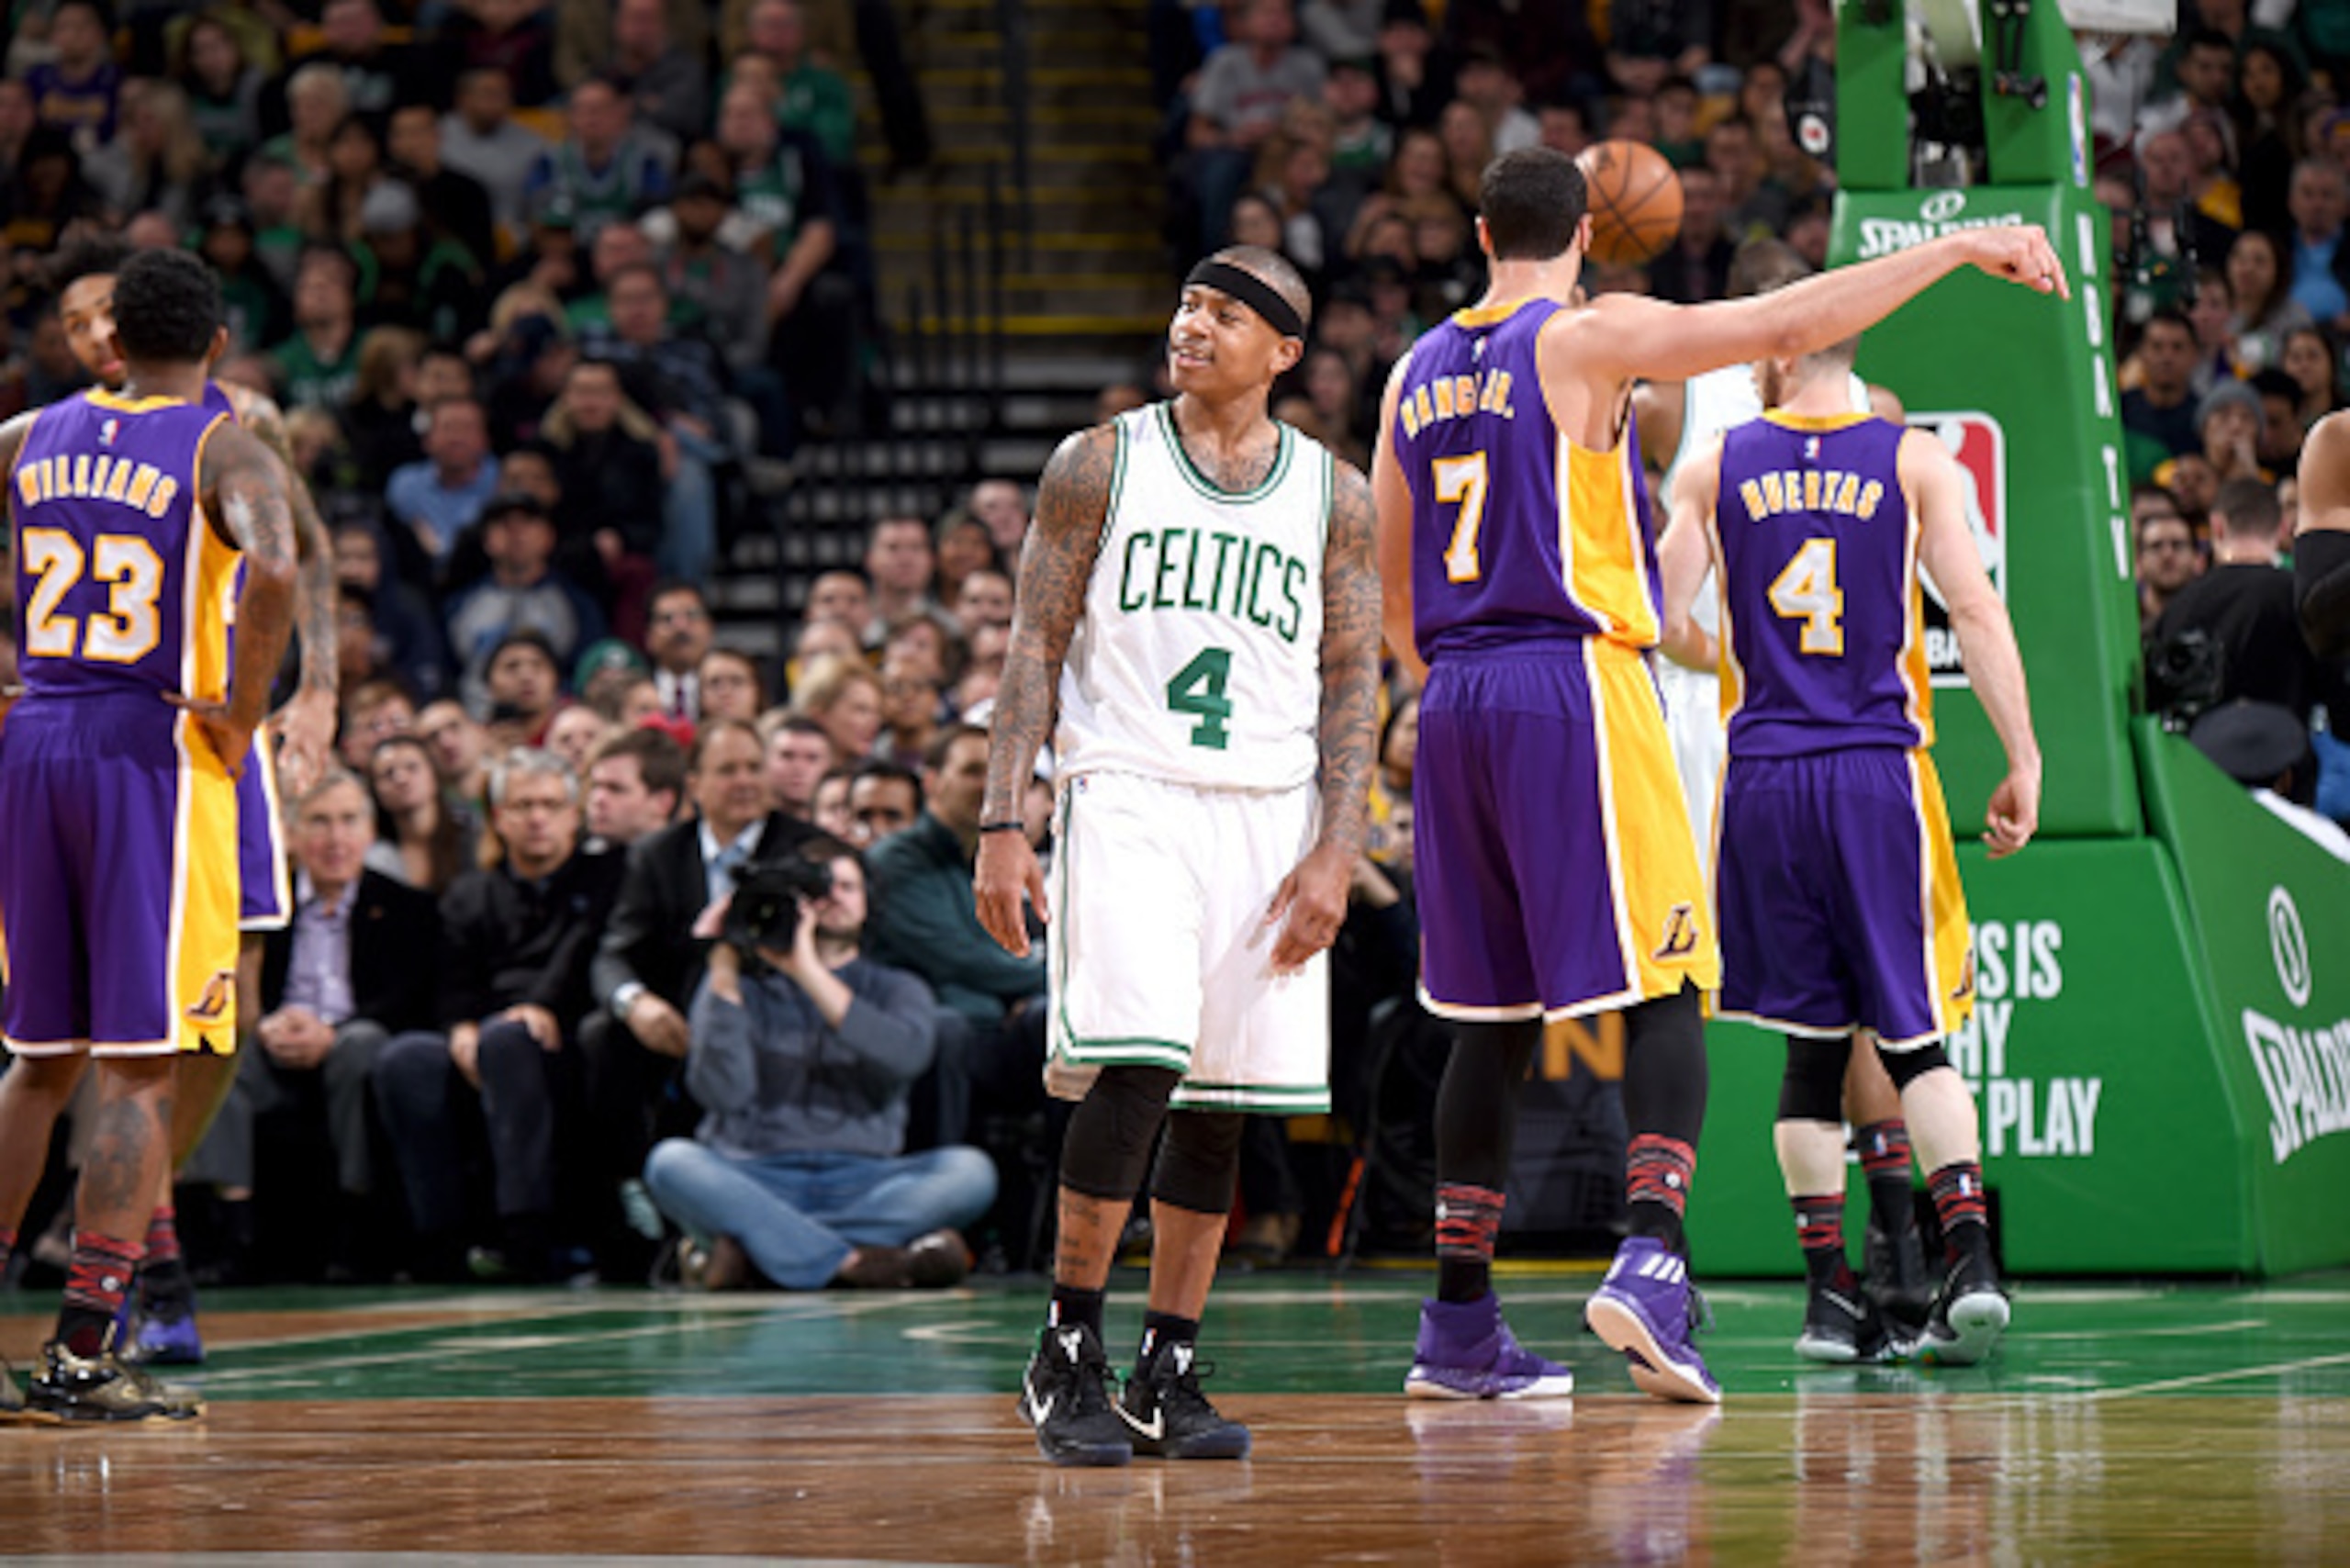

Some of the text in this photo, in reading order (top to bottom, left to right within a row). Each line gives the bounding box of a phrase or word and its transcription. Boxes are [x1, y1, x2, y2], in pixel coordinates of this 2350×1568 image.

[17, 454, 179, 518] WILLIAMS
[1431, 450, 1489, 584] 7
[1740, 470, 1885, 521] HUERTAS
[21, 527, 166, 664] 23
[1118, 528, 1307, 644] CELTICS
[1767, 538, 1845, 656] 4
[1165, 647, 1233, 750] 4
[2014, 920, 2063, 999] IS
[1947, 1001, 2015, 1077] HY
[1986, 1078, 2102, 1157] PLAY
